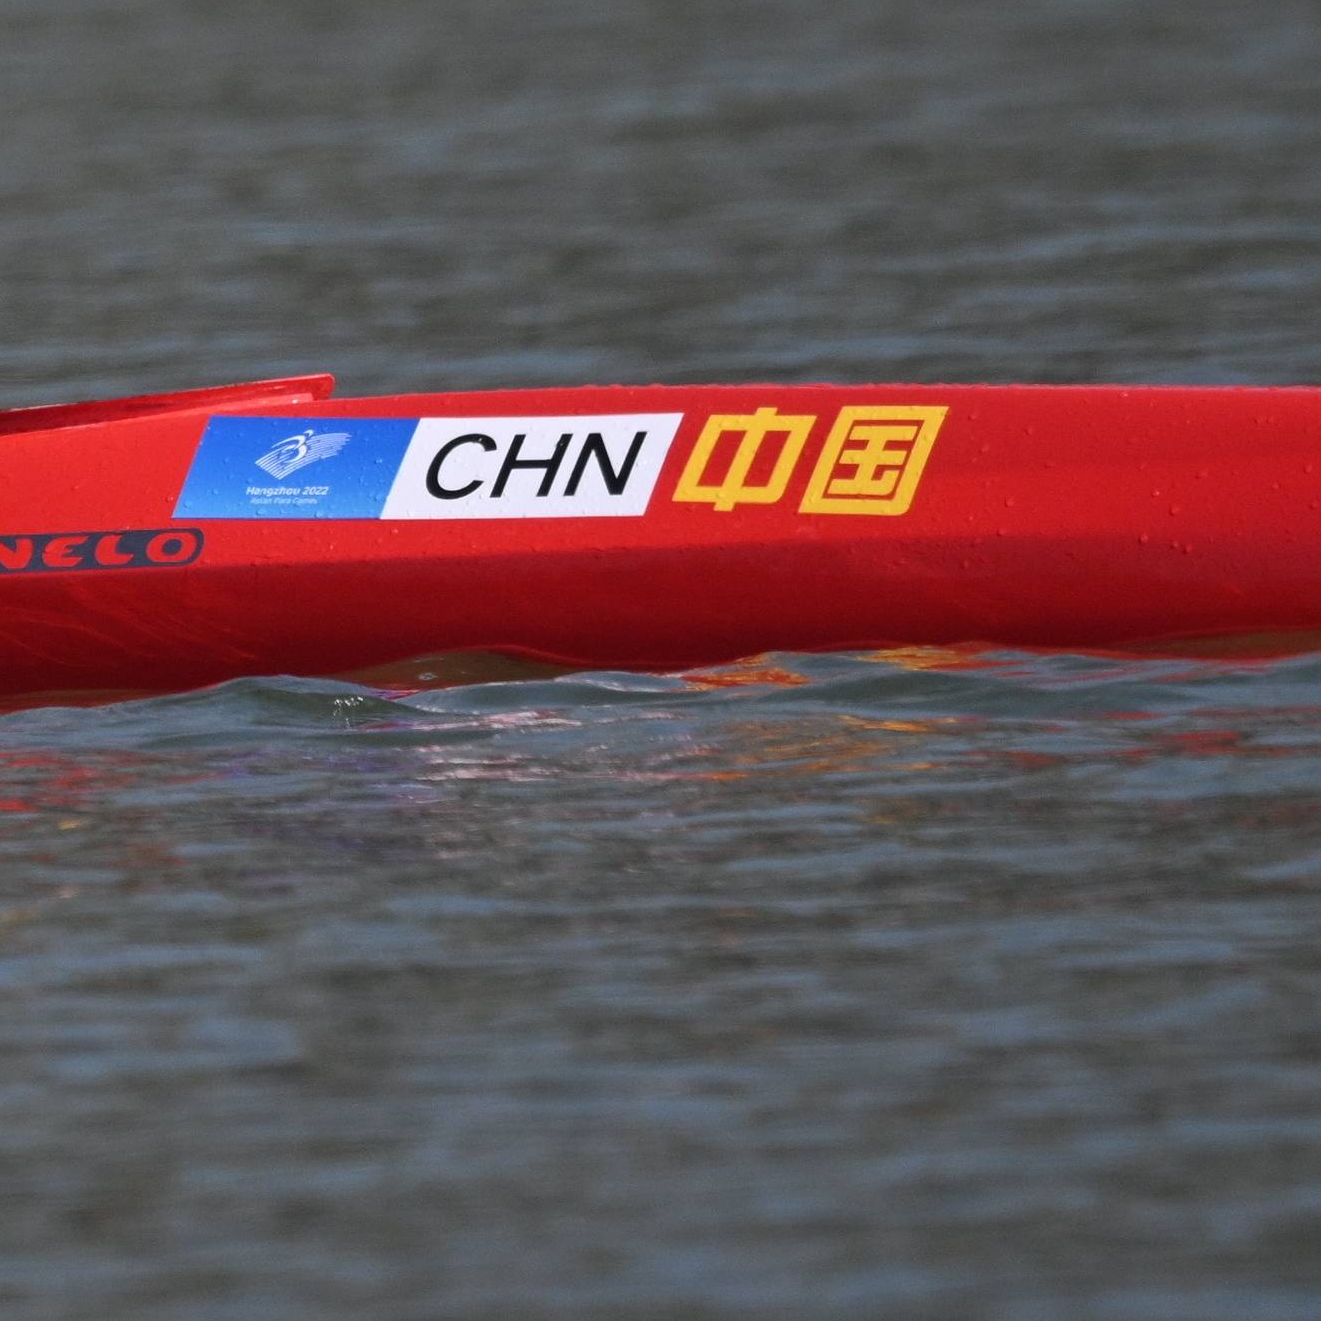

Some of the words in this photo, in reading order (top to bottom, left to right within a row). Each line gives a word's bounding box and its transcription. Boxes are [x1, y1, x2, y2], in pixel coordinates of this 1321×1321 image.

[245, 486, 301, 497] Hangzhou
[301, 486, 330, 495] 2022
[425, 431, 648, 501] CHN
[671, 405, 950, 517] 中国
